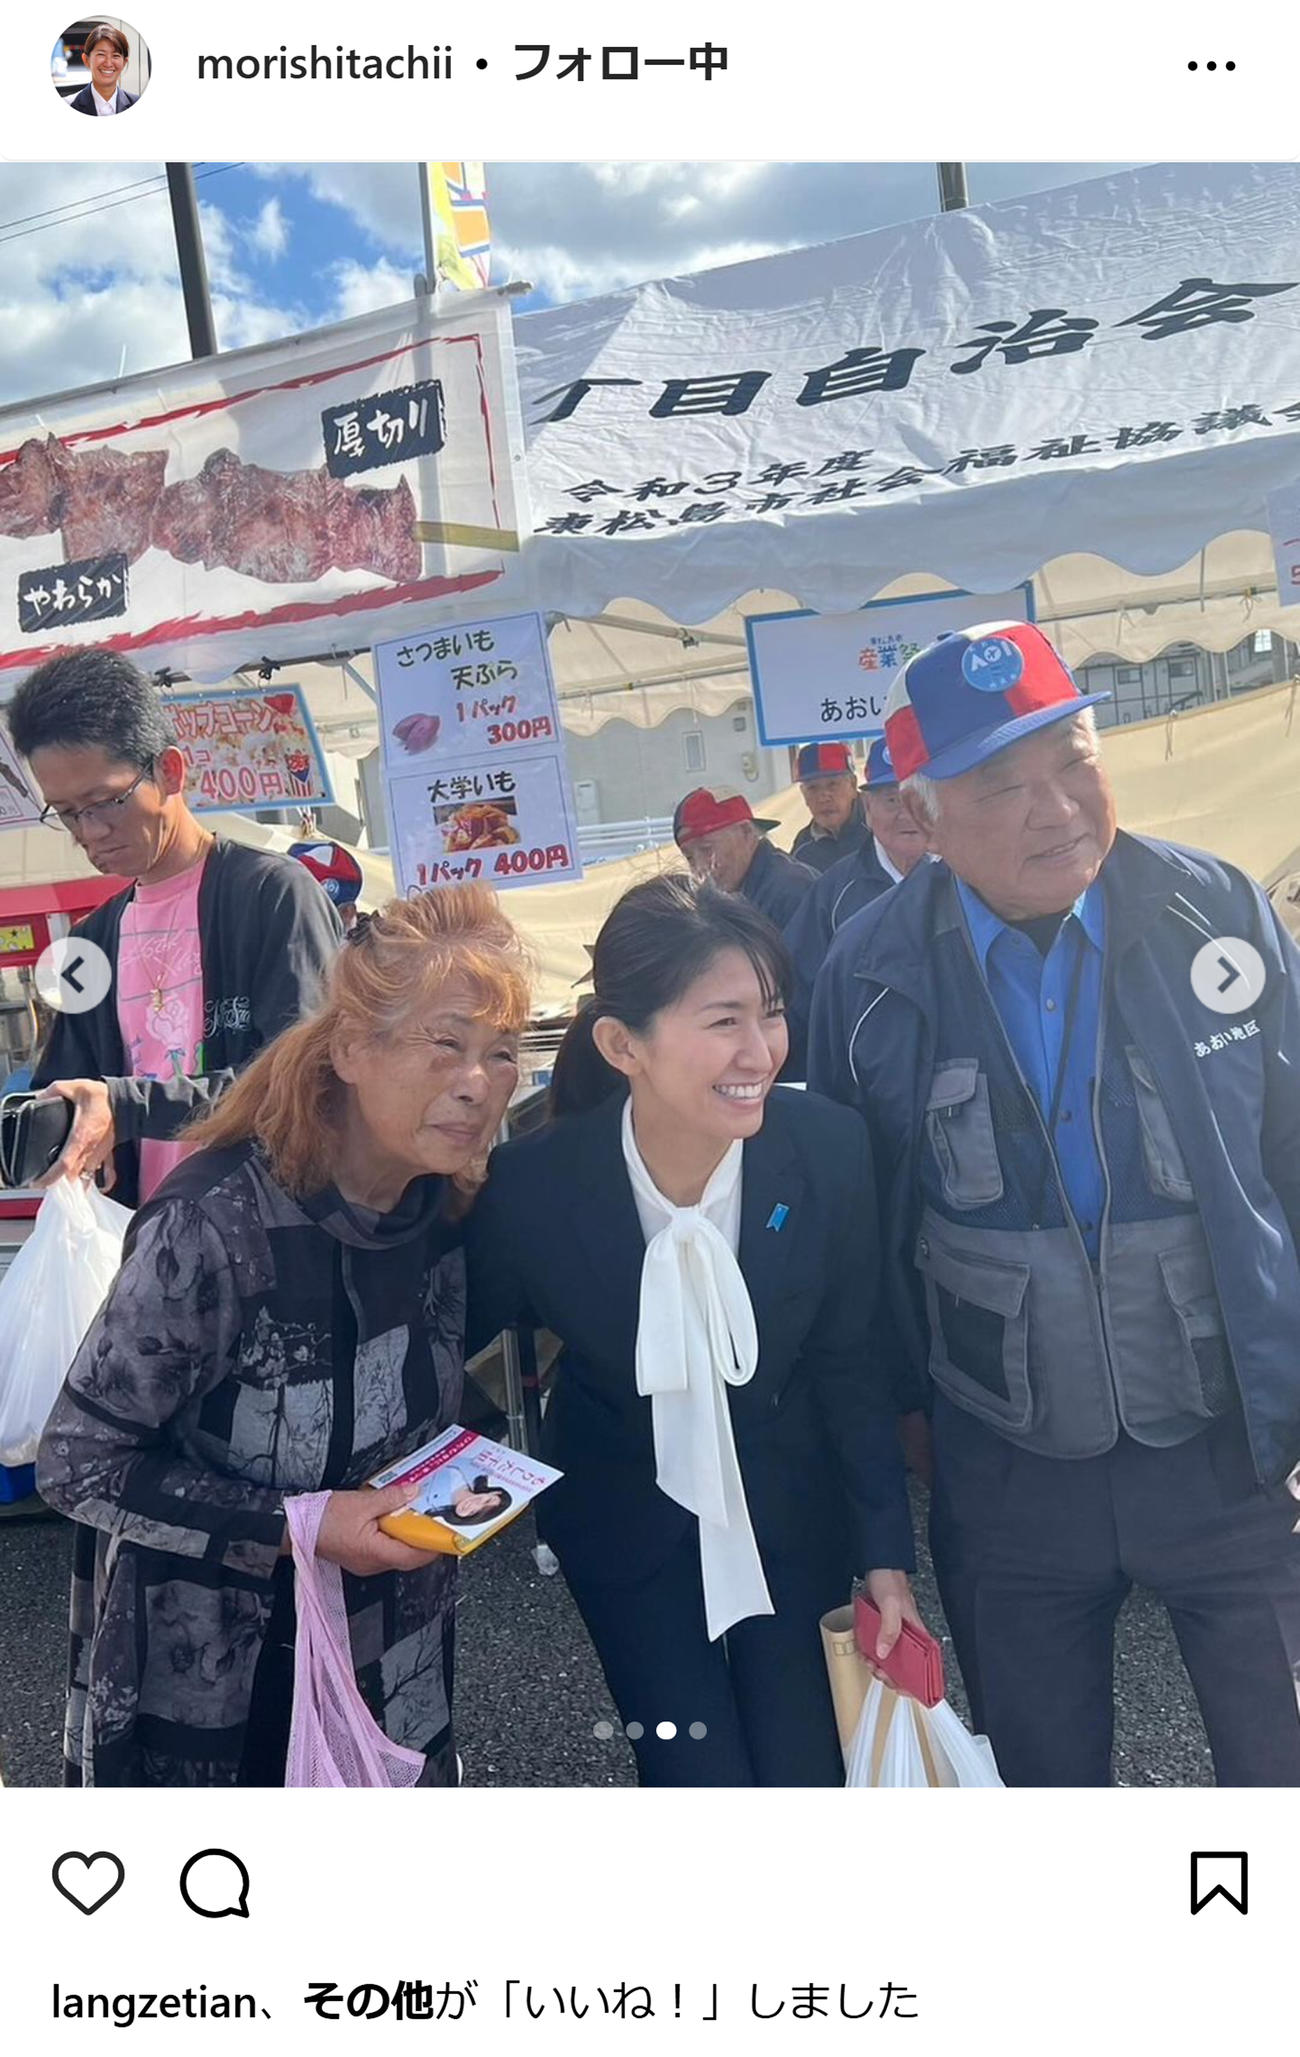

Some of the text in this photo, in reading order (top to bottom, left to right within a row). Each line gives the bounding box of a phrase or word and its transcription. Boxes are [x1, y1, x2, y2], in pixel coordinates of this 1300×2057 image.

[530, 278, 1299, 425] 丁目自治会
[332, 399, 430, 456] 厚切り
[561, 449, 875, 502] 令和3年度
[23, 574, 124, 616] やわらか
[396, 630, 495, 667] さつまいも
[450, 659, 518, 690] 天ぷら
[487, 716, 553, 745] 300円
[200, 766, 285, 801] 400円
[427, 770, 517, 803] 大学いも
[494, 843, 569, 875] 400円
[1193, 1019, 1261, 1057] あおい地区
